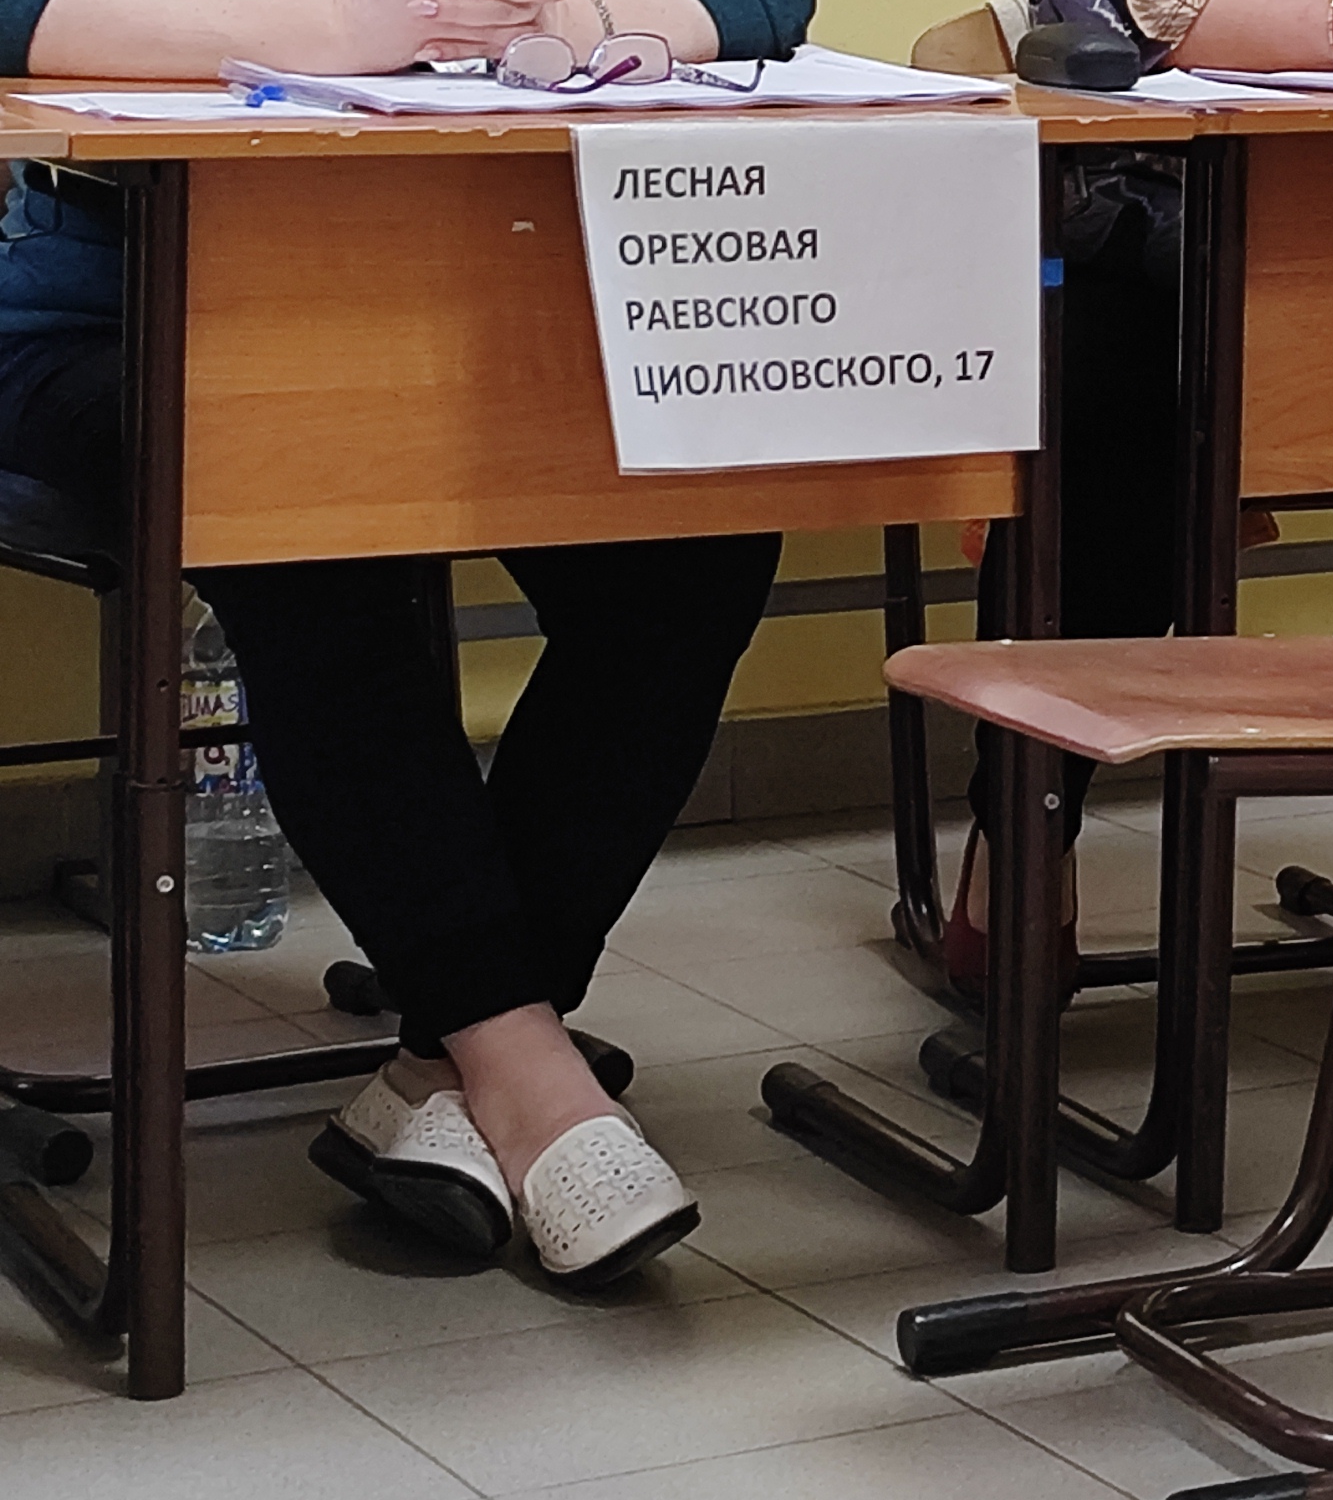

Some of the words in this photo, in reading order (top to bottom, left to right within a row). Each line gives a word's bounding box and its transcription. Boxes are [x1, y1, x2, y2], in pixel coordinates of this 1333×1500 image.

[613, 165, 766, 199] ЛЕСНАЯ
[618, 228, 819, 265] ОРЕХОВАЯ
[625, 293, 837, 331] РАЕВСКОГО
[633, 352, 943, 403] ЦИОЛКОВСКОГО,
[954, 350, 994, 382] 17
